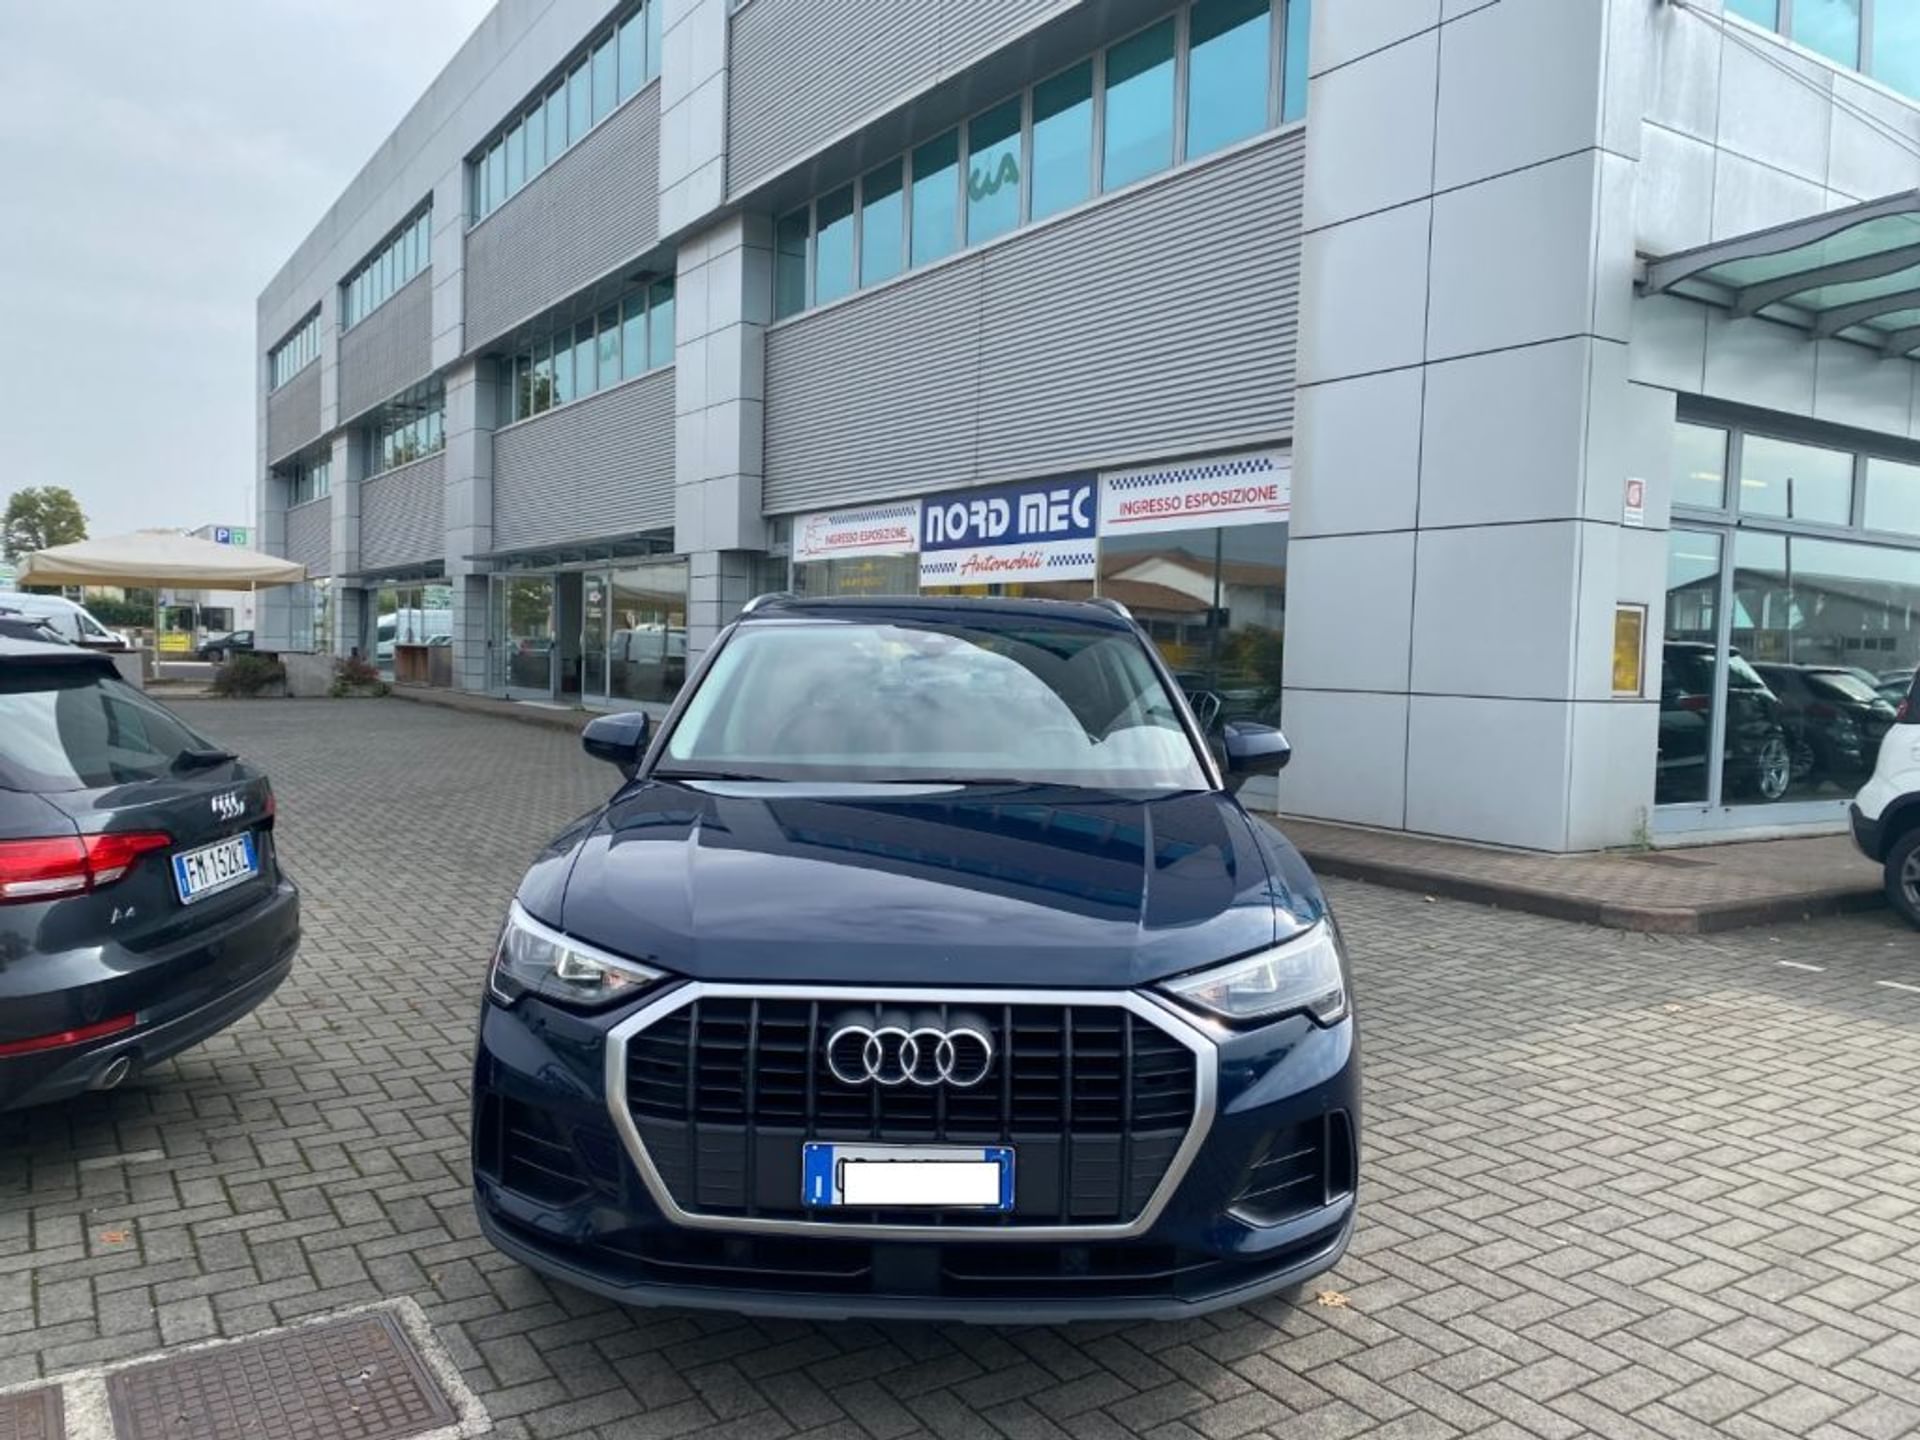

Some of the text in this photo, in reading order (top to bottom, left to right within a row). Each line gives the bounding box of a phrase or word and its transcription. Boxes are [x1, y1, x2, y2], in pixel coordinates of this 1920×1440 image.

[1119, 484, 1278, 516] INGRESSO ESPOSIZIONE
[926, 486, 1091, 543] NORD MEC
[825, 527, 907, 545] INGRESSO ESPOSIZIONE
[960, 551, 1044, 576] Automobili
